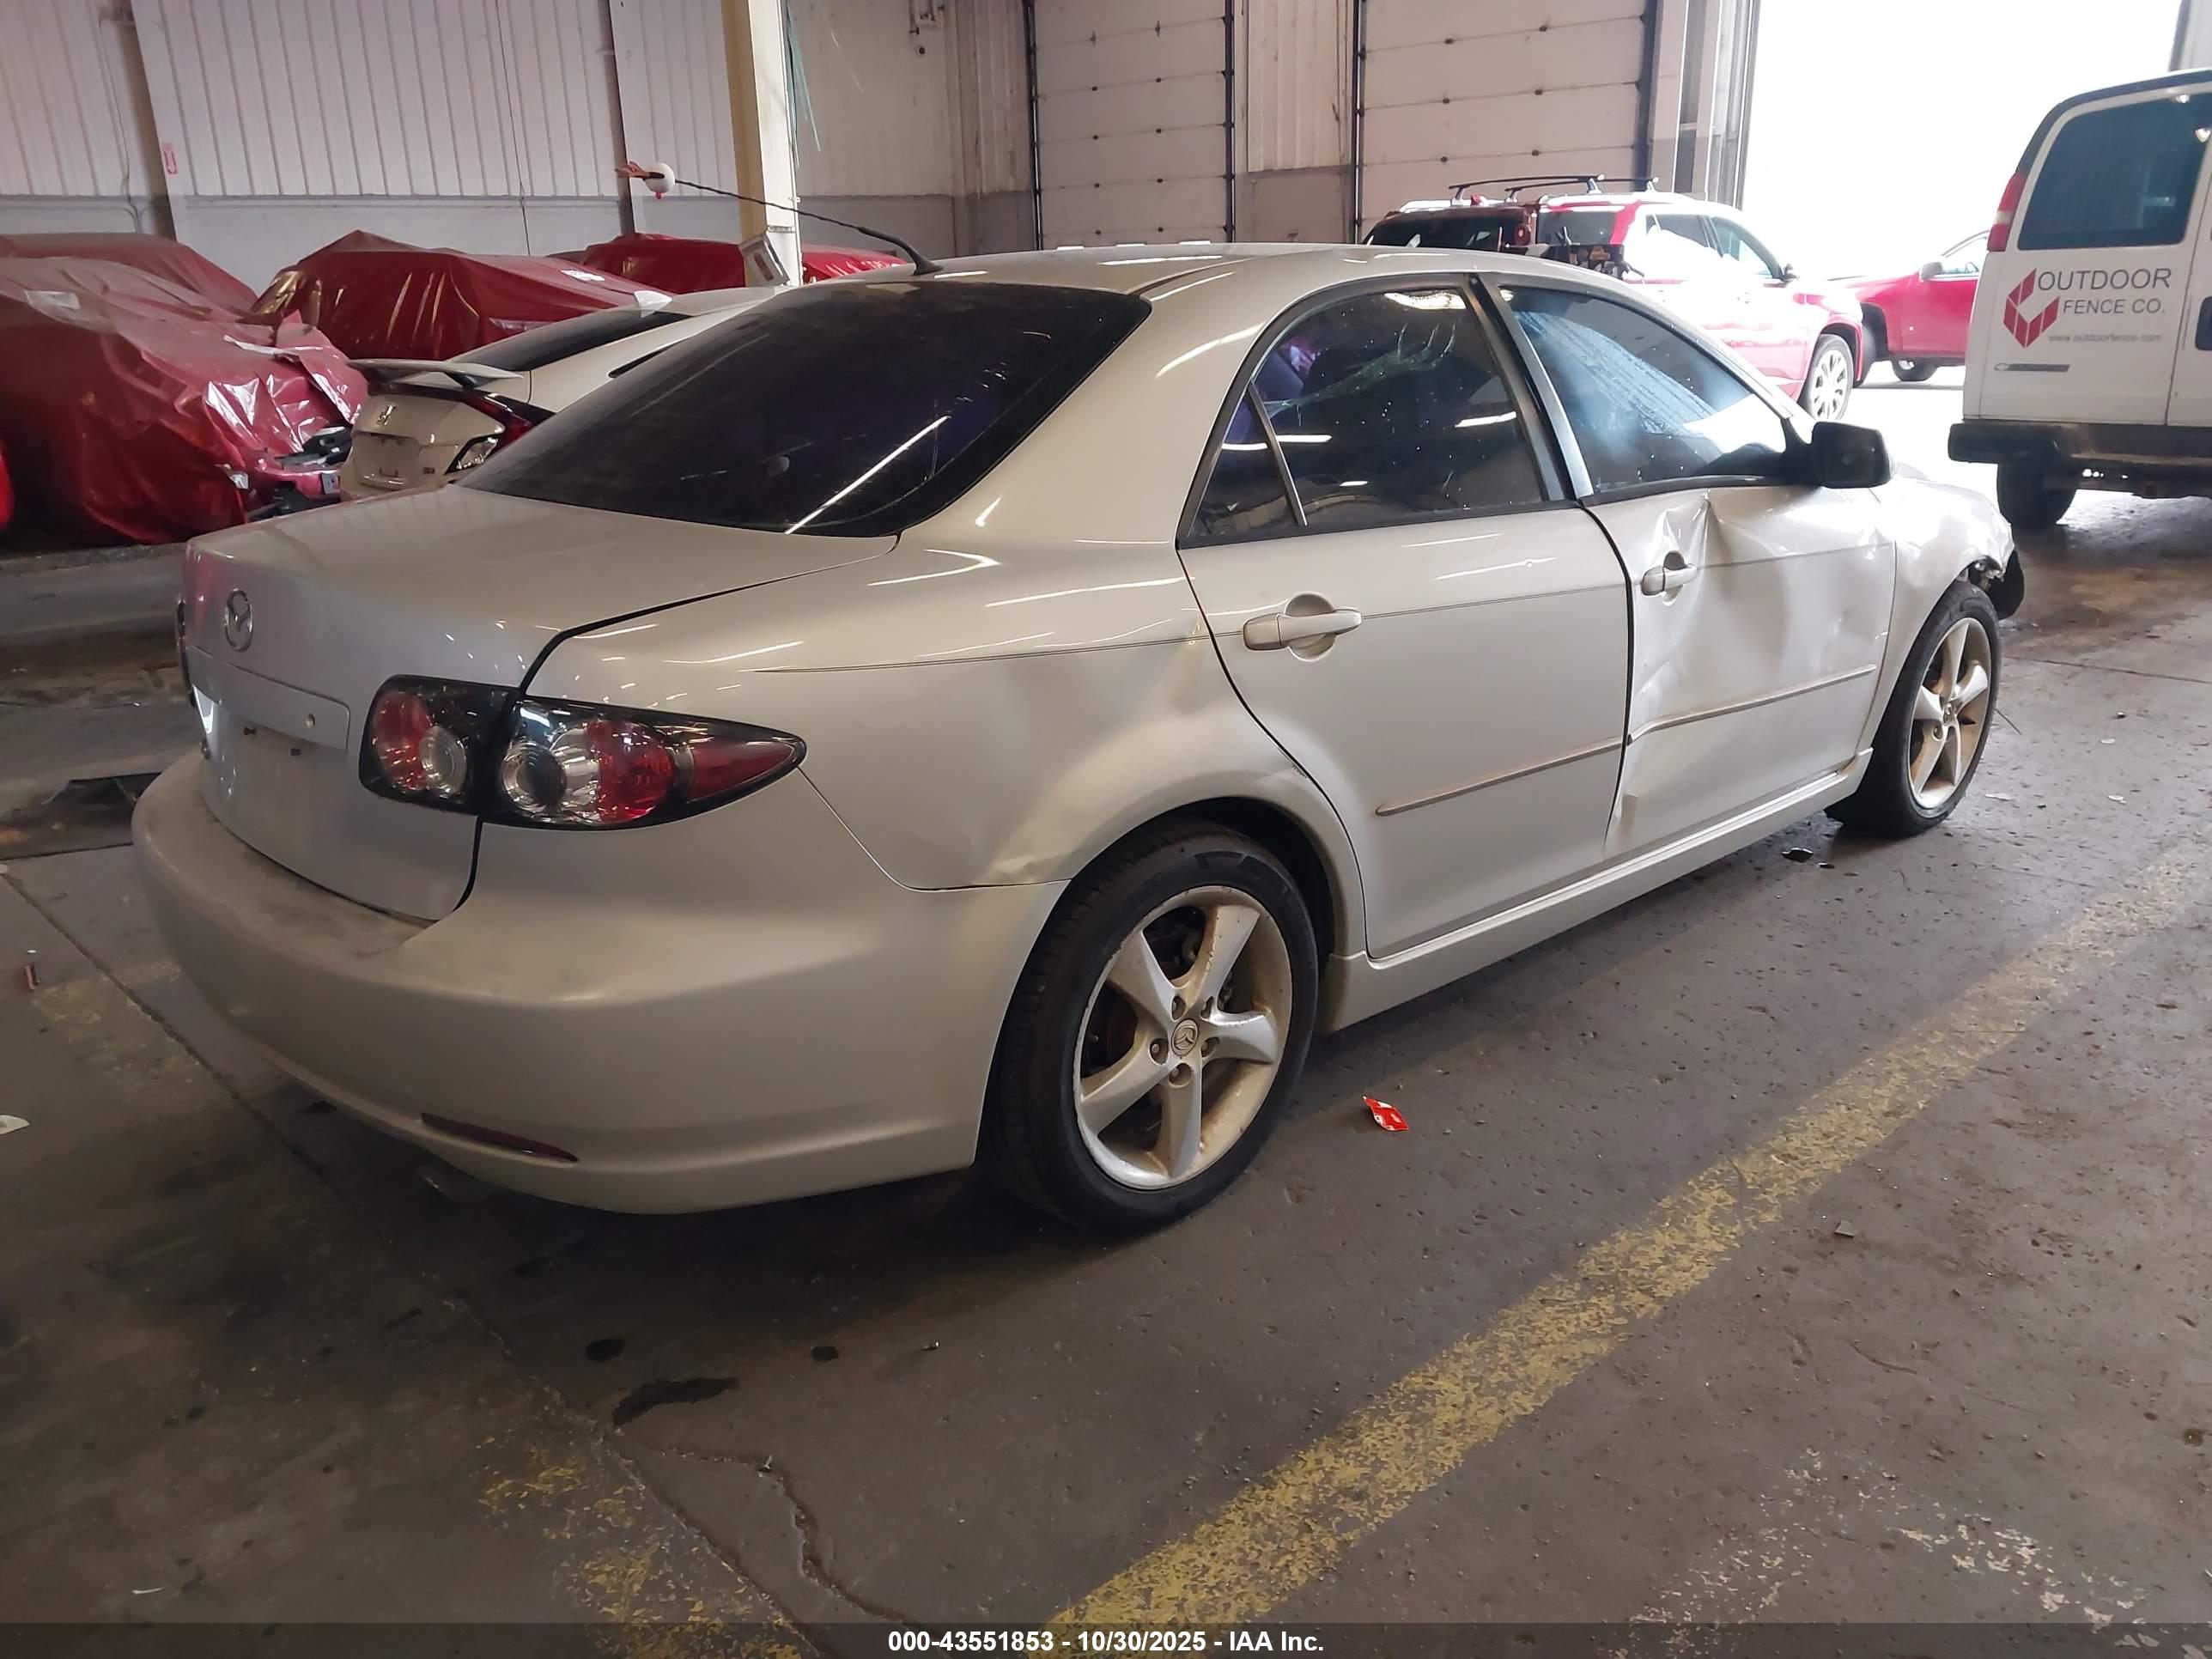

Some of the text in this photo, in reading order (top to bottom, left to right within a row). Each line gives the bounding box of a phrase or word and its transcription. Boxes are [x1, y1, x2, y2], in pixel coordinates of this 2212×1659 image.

[2038, 268, 2172, 290] OUTDOOR
[2063, 298, 2166, 314] FENCE CO.
